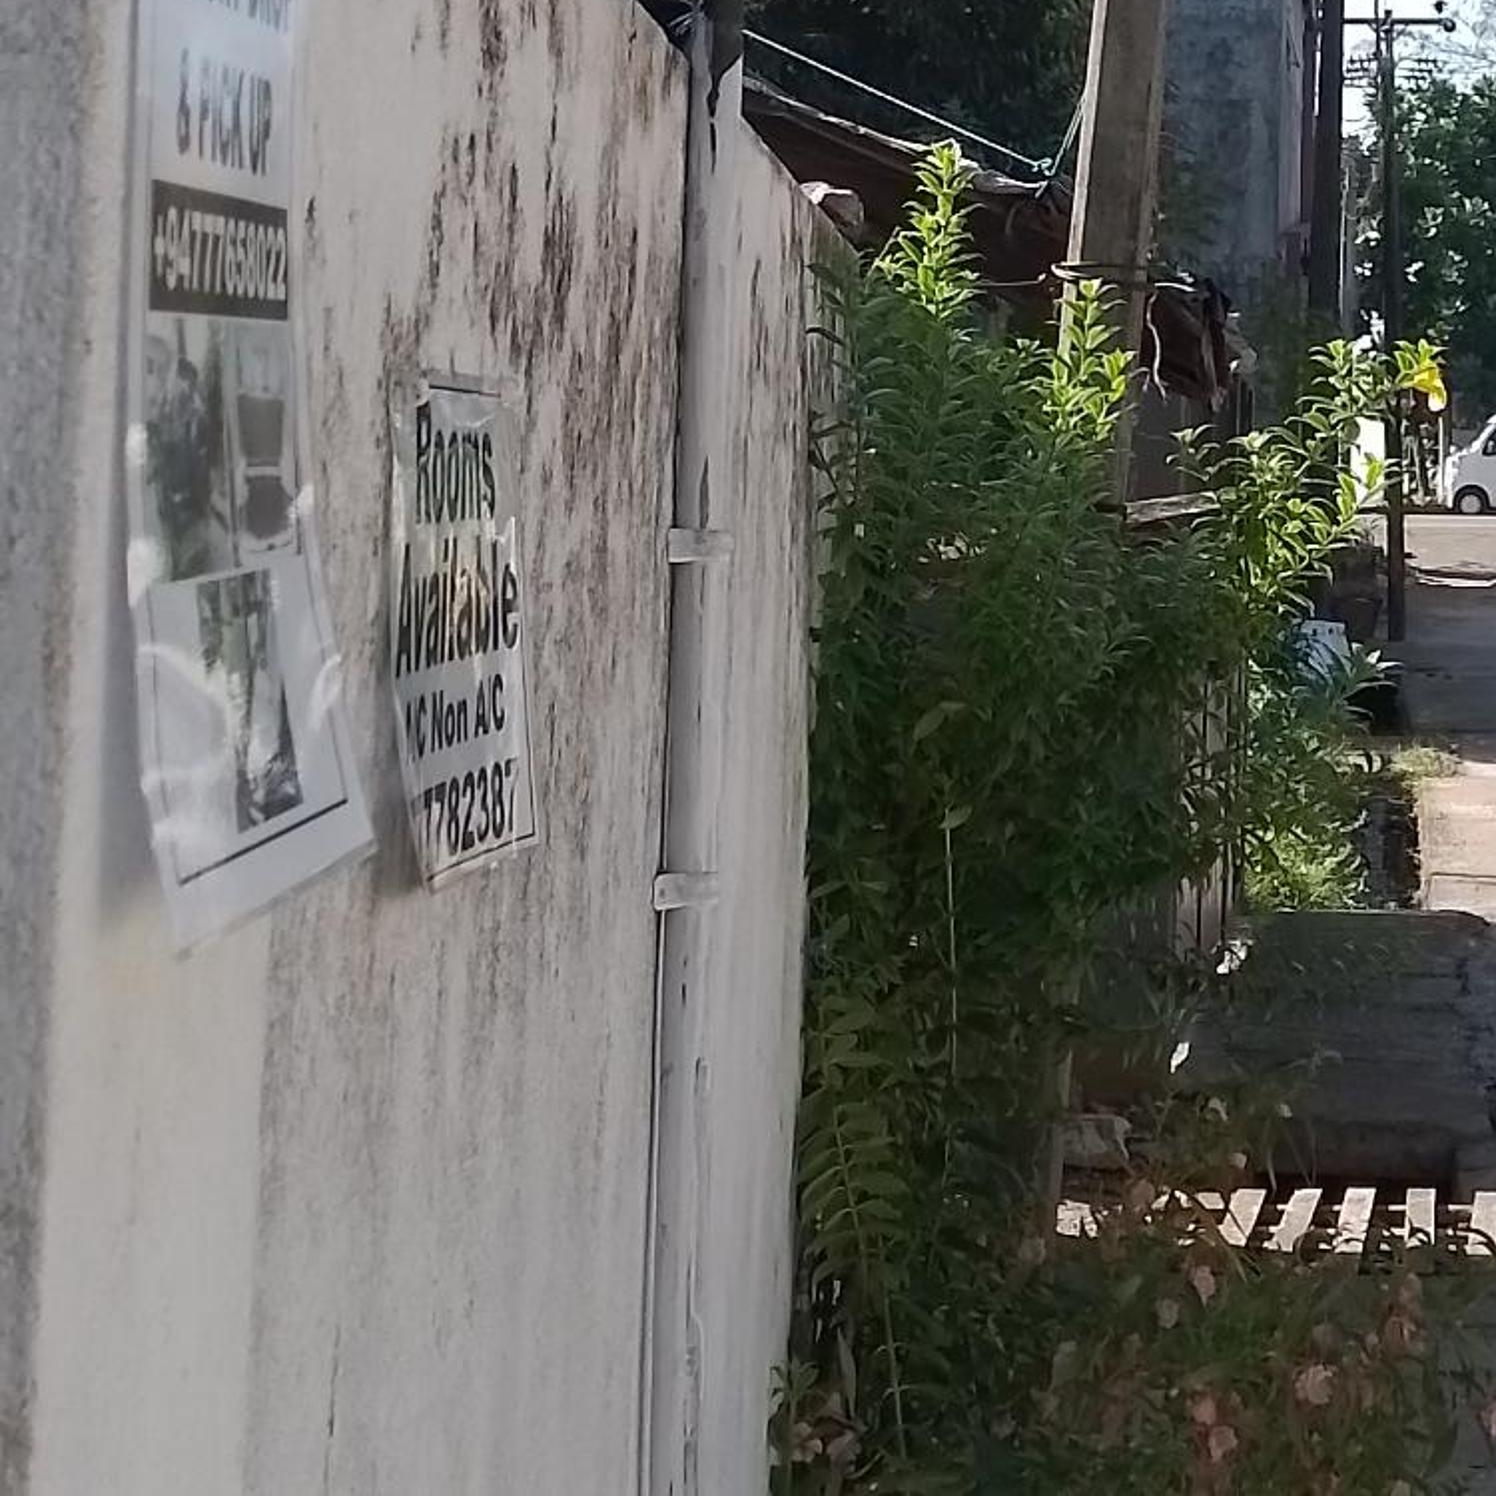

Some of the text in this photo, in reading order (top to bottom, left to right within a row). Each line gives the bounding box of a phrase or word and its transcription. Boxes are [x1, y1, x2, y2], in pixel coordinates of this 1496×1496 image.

[416, 401, 496, 524] Rooms
[396, 534, 518, 679] Available
[431, 689, 468, 753] Non
[474, 673, 505, 738] A/C
